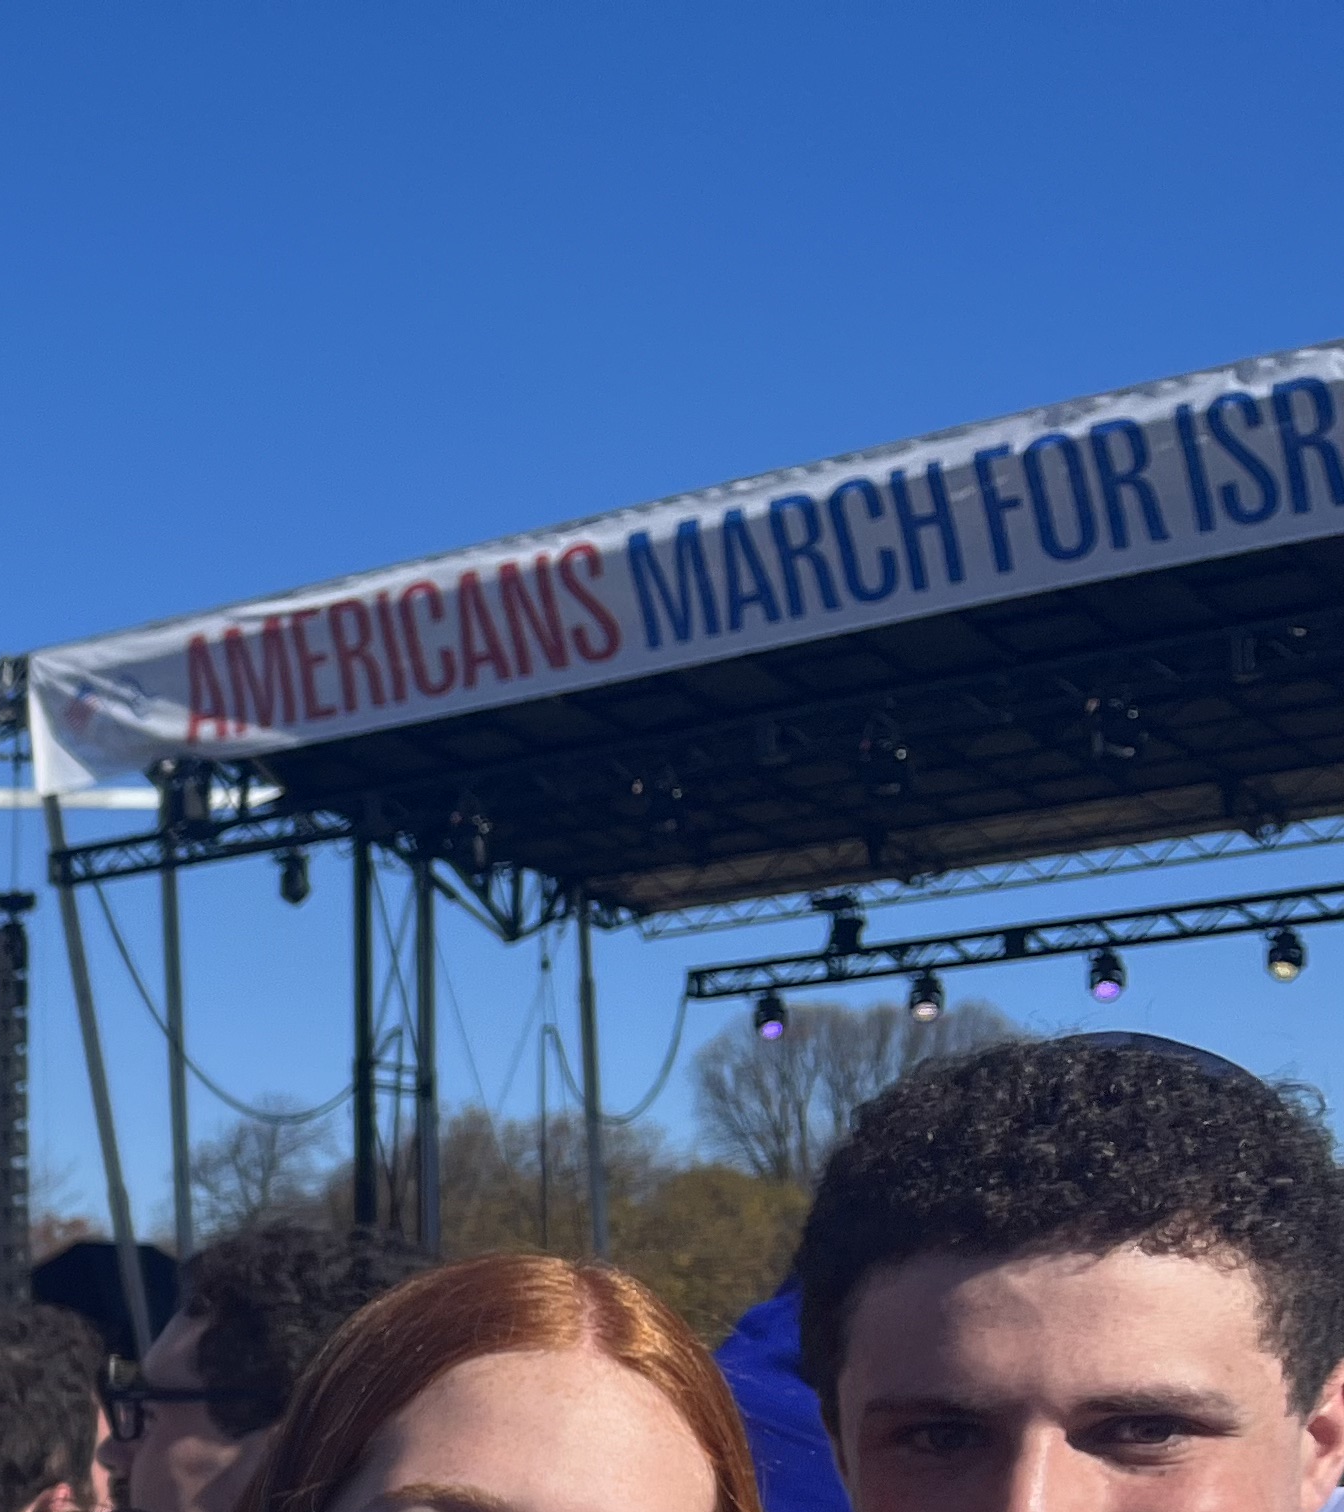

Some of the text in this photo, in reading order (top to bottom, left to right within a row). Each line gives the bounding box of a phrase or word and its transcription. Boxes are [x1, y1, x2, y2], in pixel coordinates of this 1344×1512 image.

[186, 542, 622, 746] AMERICANS
[628, 462, 966, 650] MARCH
[974, 418, 1172, 574] FOR
